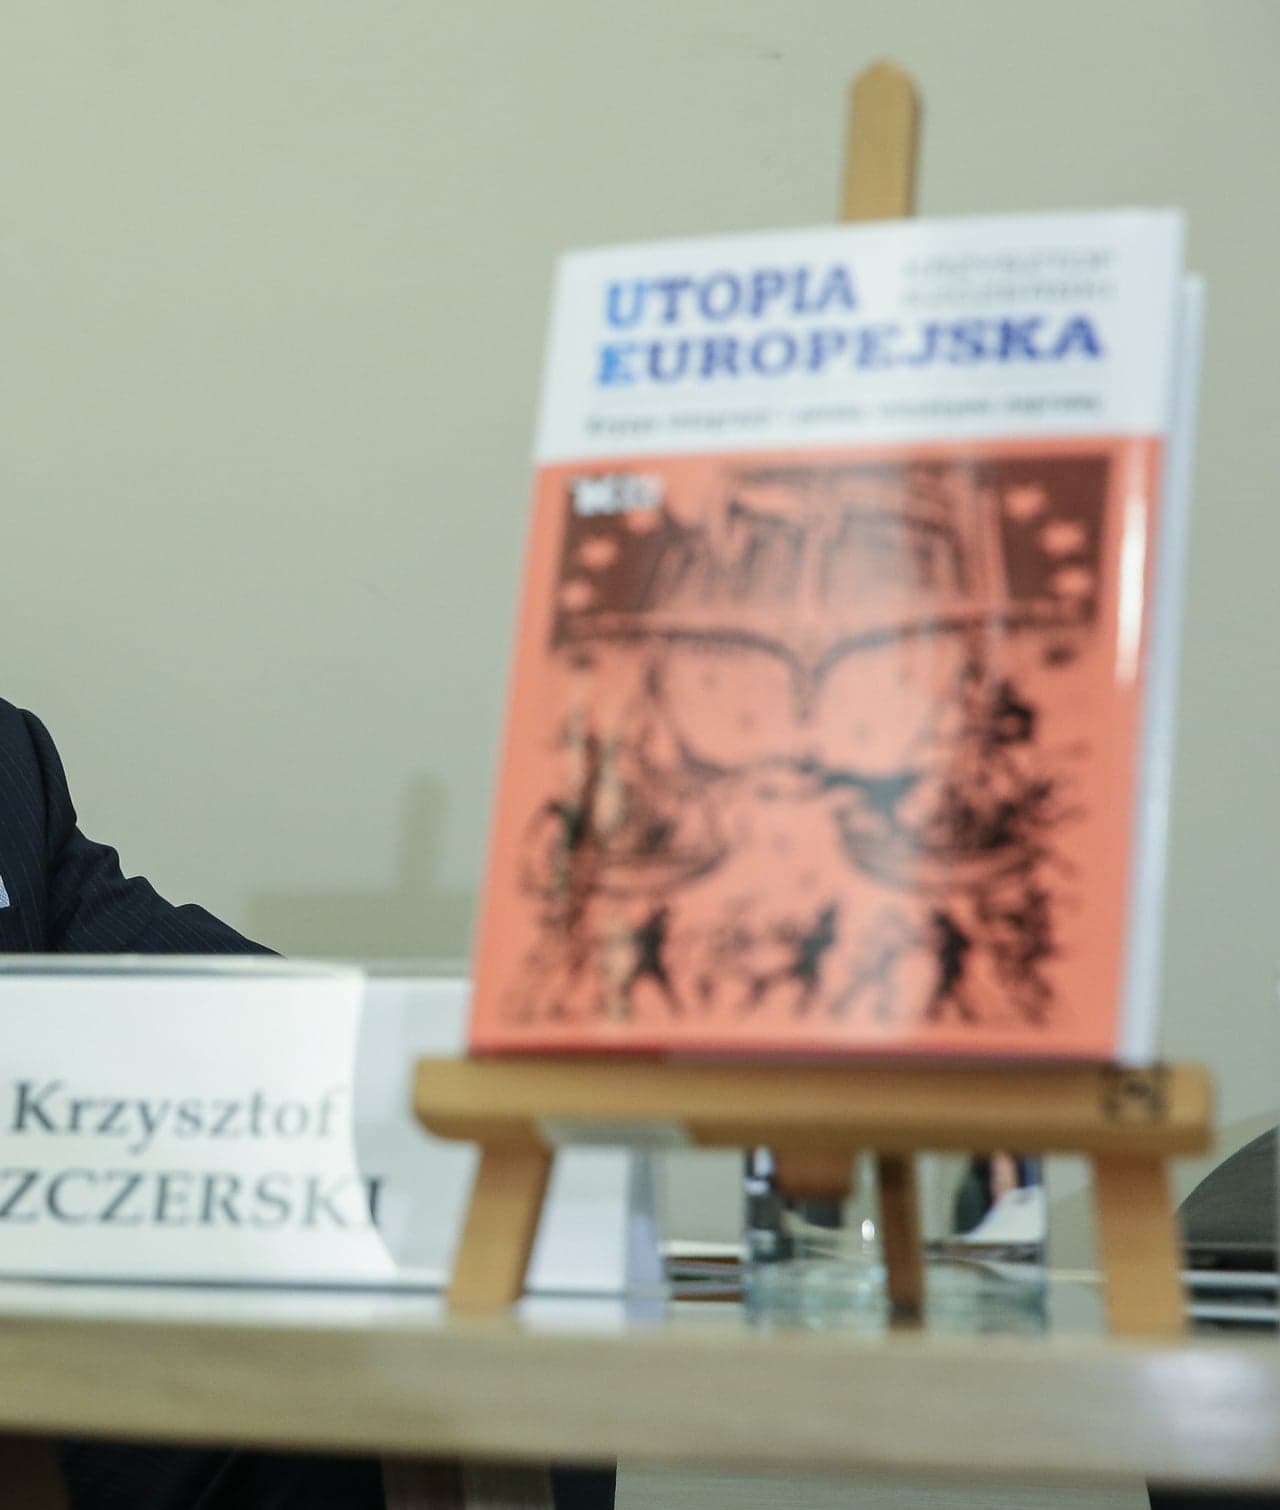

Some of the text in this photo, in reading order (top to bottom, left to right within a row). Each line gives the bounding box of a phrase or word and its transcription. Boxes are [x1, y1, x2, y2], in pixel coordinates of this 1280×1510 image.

[605, 264, 858, 329] UTOPIA
[593, 314, 1105, 388] EUROPEJSKA
[7, 1080, 344, 1153] Krzysztof
